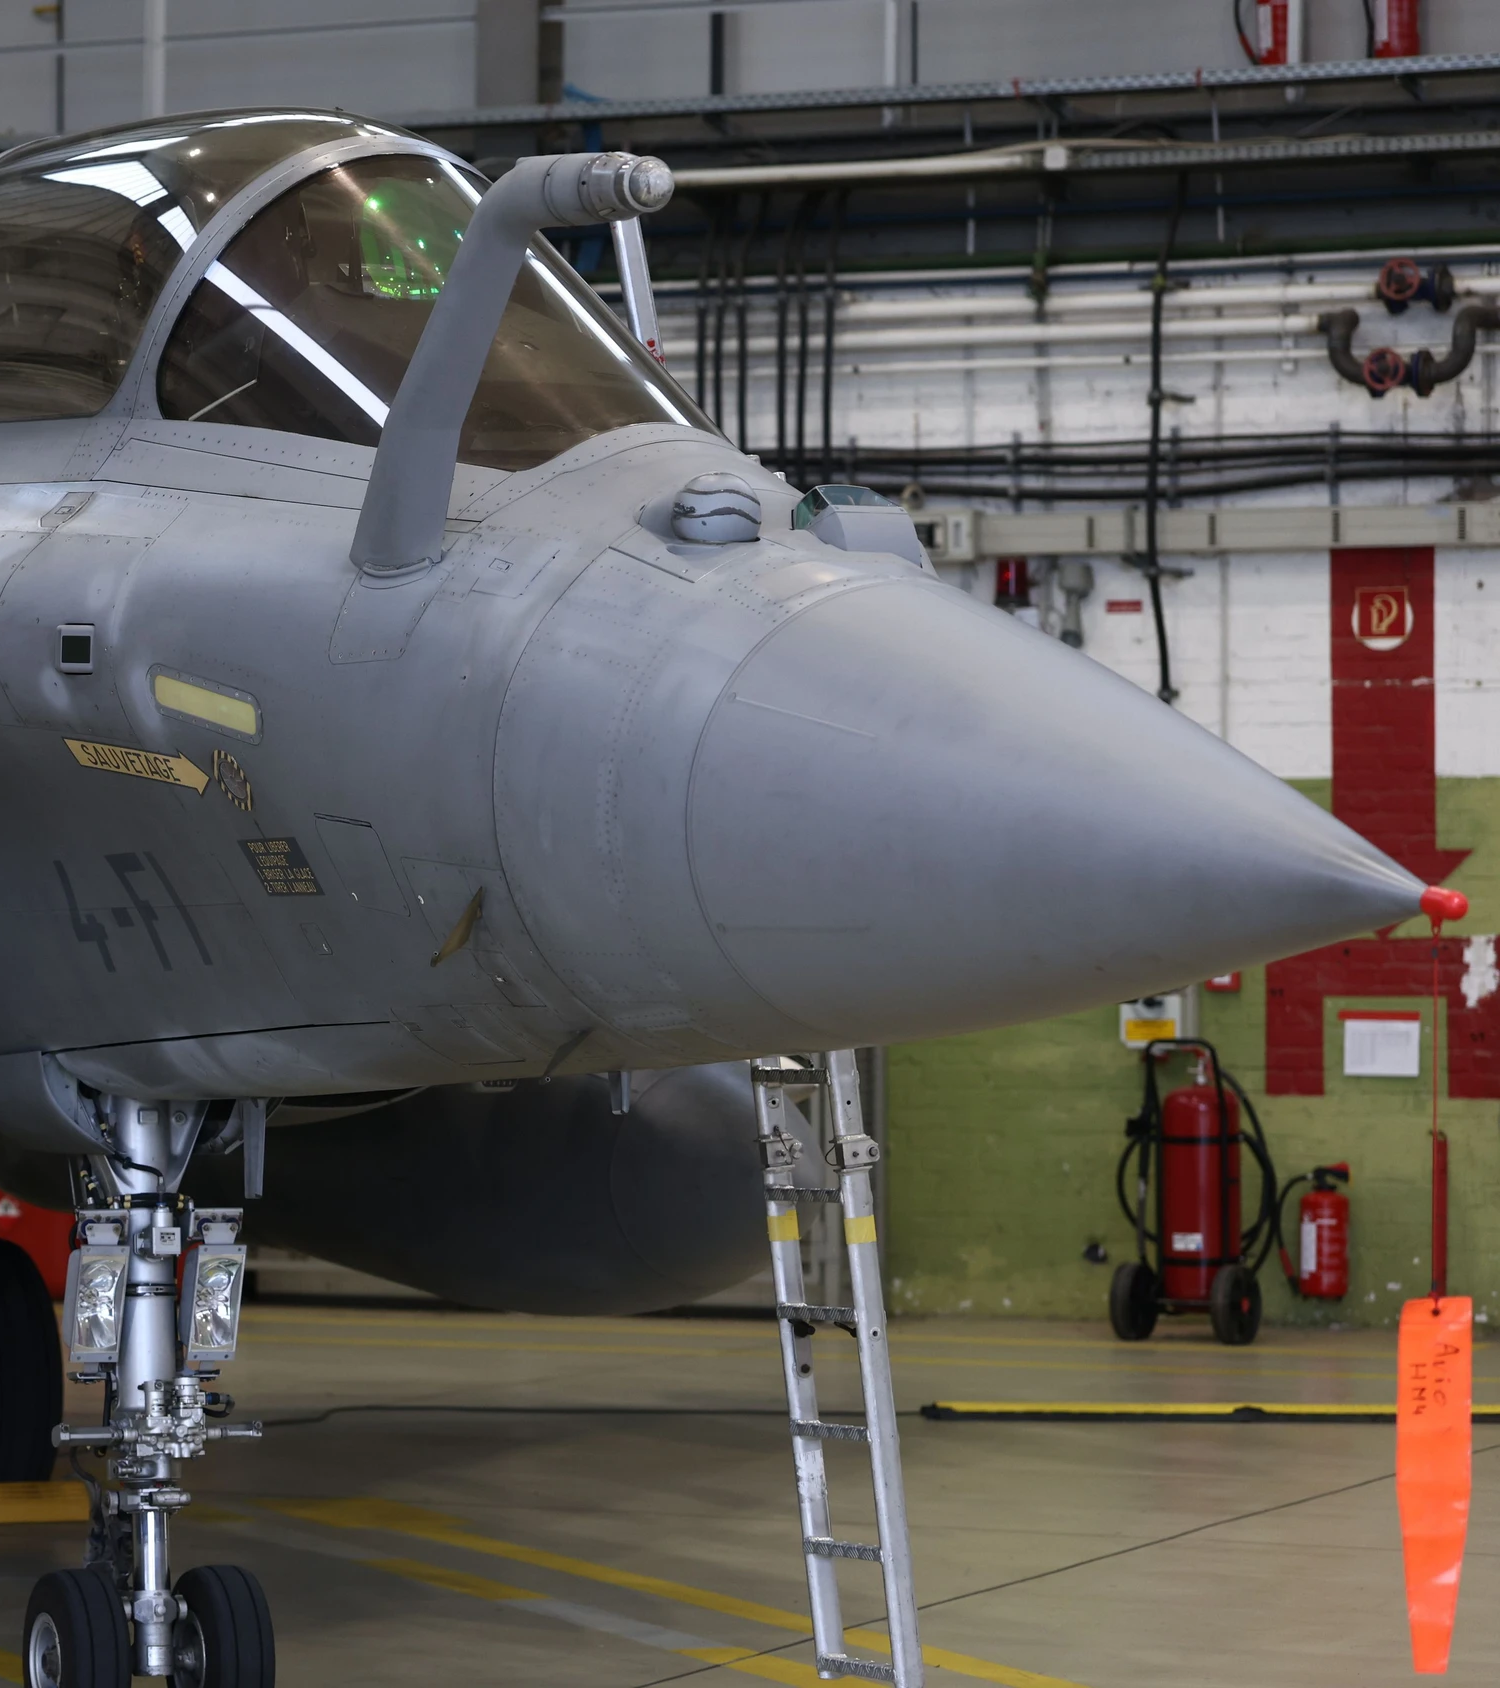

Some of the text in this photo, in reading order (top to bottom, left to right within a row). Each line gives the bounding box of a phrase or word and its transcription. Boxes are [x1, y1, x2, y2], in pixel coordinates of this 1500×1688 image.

[81, 743, 181, 783] SAUVETAGE
[247, 842, 266, 854] POUR
[293, 867, 315, 879] GLACE
